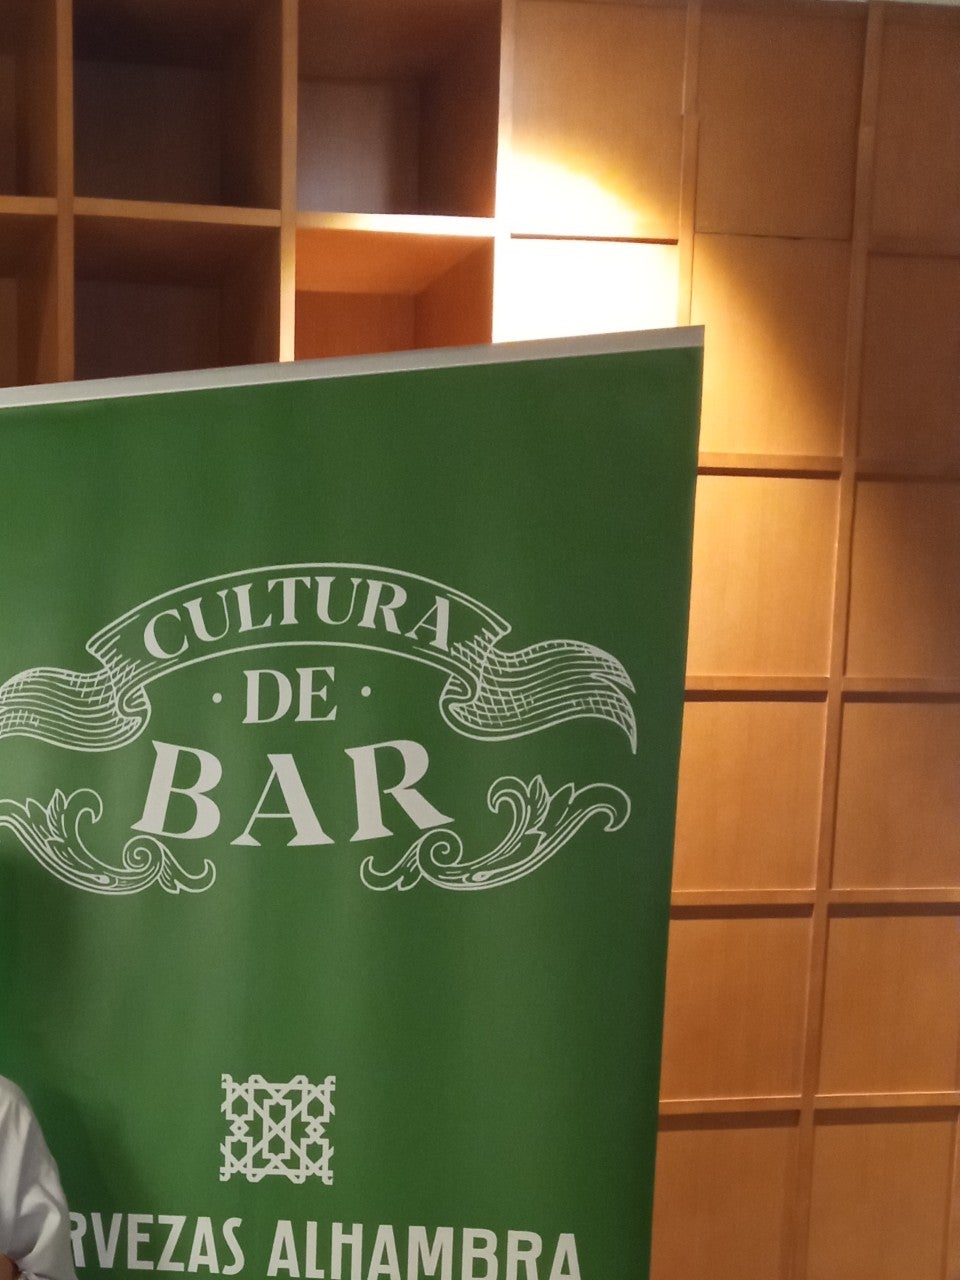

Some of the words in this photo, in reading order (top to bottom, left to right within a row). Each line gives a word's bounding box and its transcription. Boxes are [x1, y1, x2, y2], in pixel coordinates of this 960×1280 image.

[143, 576, 450, 659] CULTURA
[242, 666, 338, 723] DE
[131, 739, 454, 847] BAR
[69, 1211, 245, 1276] RVEZAS
